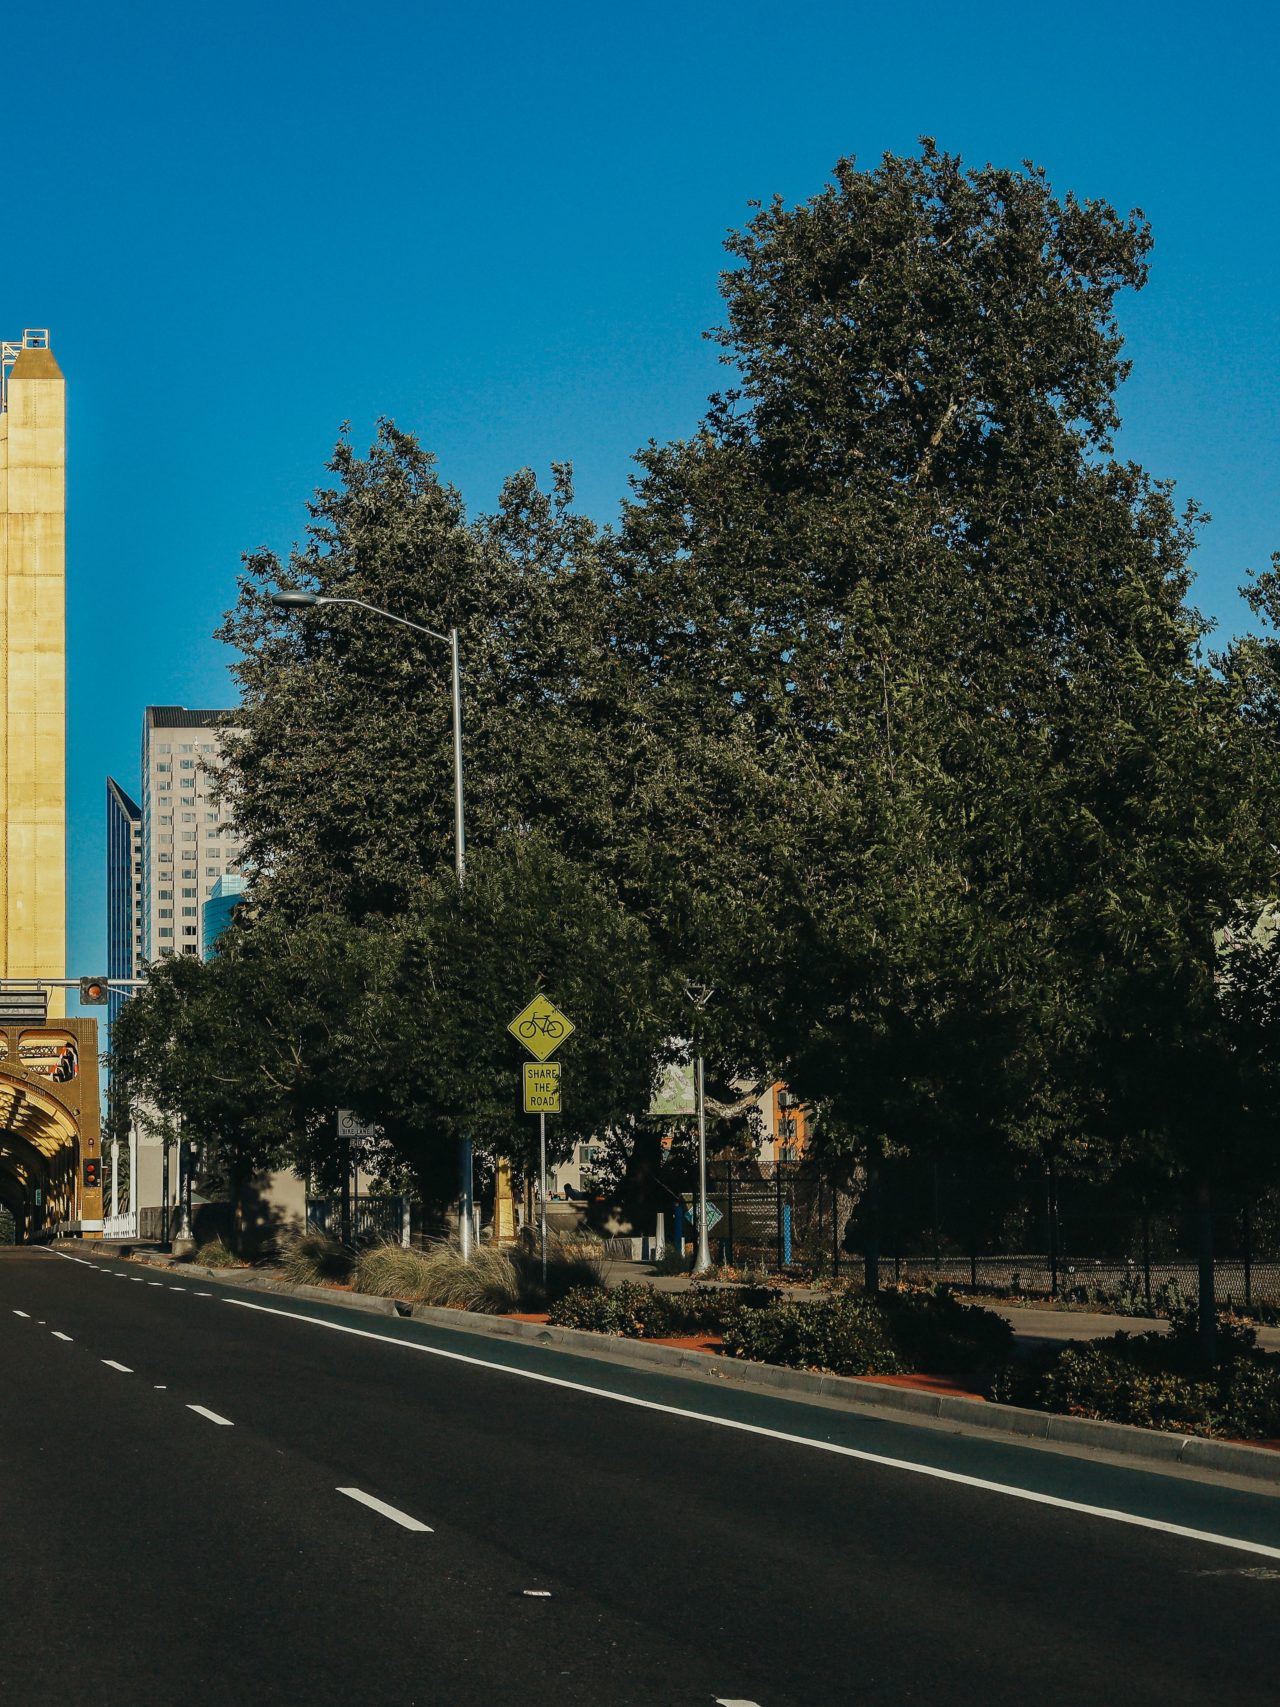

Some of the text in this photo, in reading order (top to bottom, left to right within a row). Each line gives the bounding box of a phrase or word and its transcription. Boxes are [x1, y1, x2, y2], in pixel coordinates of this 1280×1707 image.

[528, 1070, 556, 1079] SHARE
[534, 1083, 550, 1092] THE
[531, 1097, 554, 1106] ROAD
